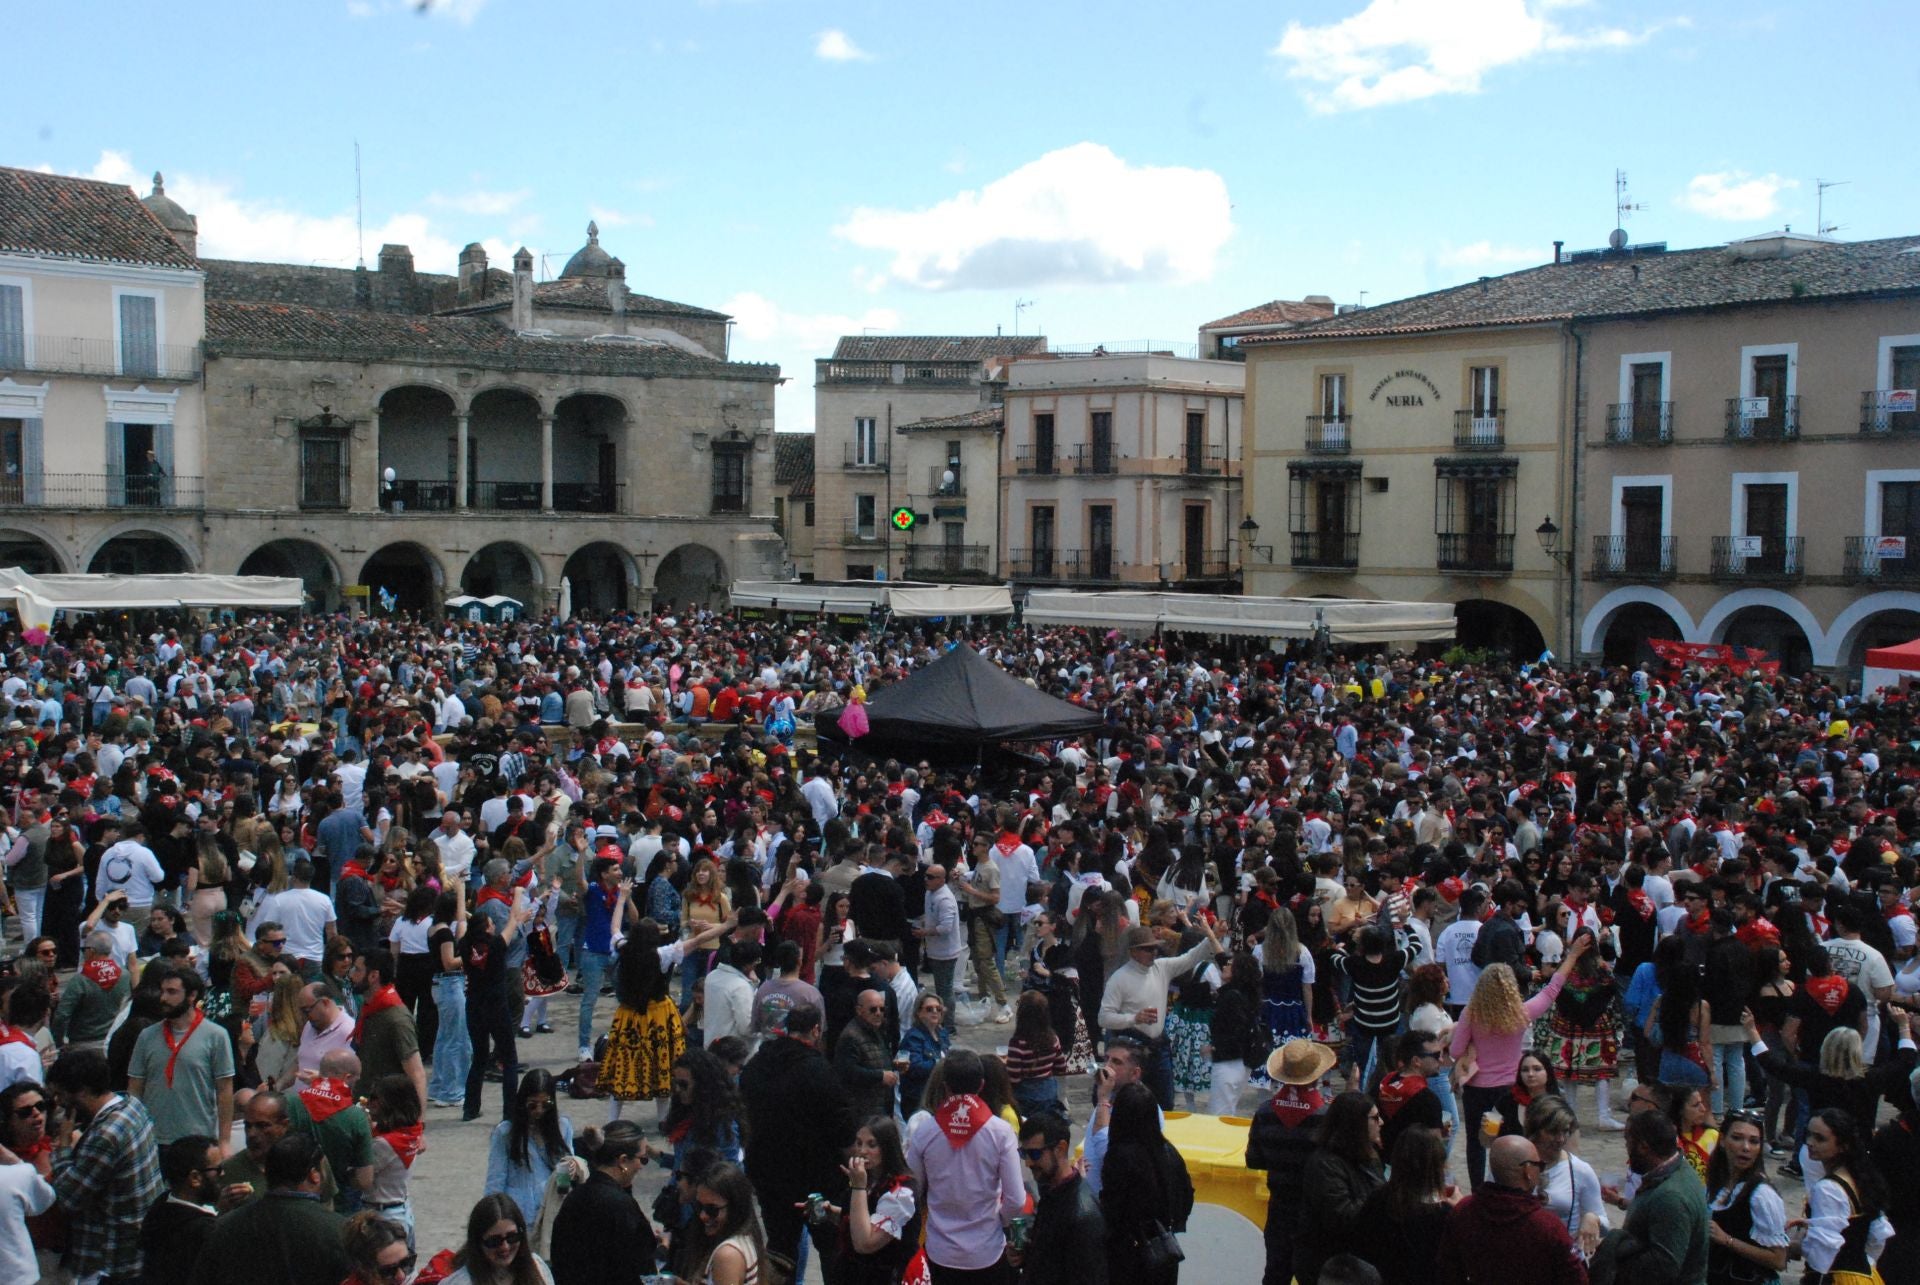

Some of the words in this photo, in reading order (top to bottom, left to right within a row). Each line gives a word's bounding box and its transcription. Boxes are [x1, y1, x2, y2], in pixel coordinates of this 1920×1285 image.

[1370, 375, 1392, 401] HOSTAL
[1395, 370, 1441, 401] RESTAURANTE
[1386, 395, 1424, 407] NURIA
[1275, 1099, 1311, 1110] TRUJILLO
